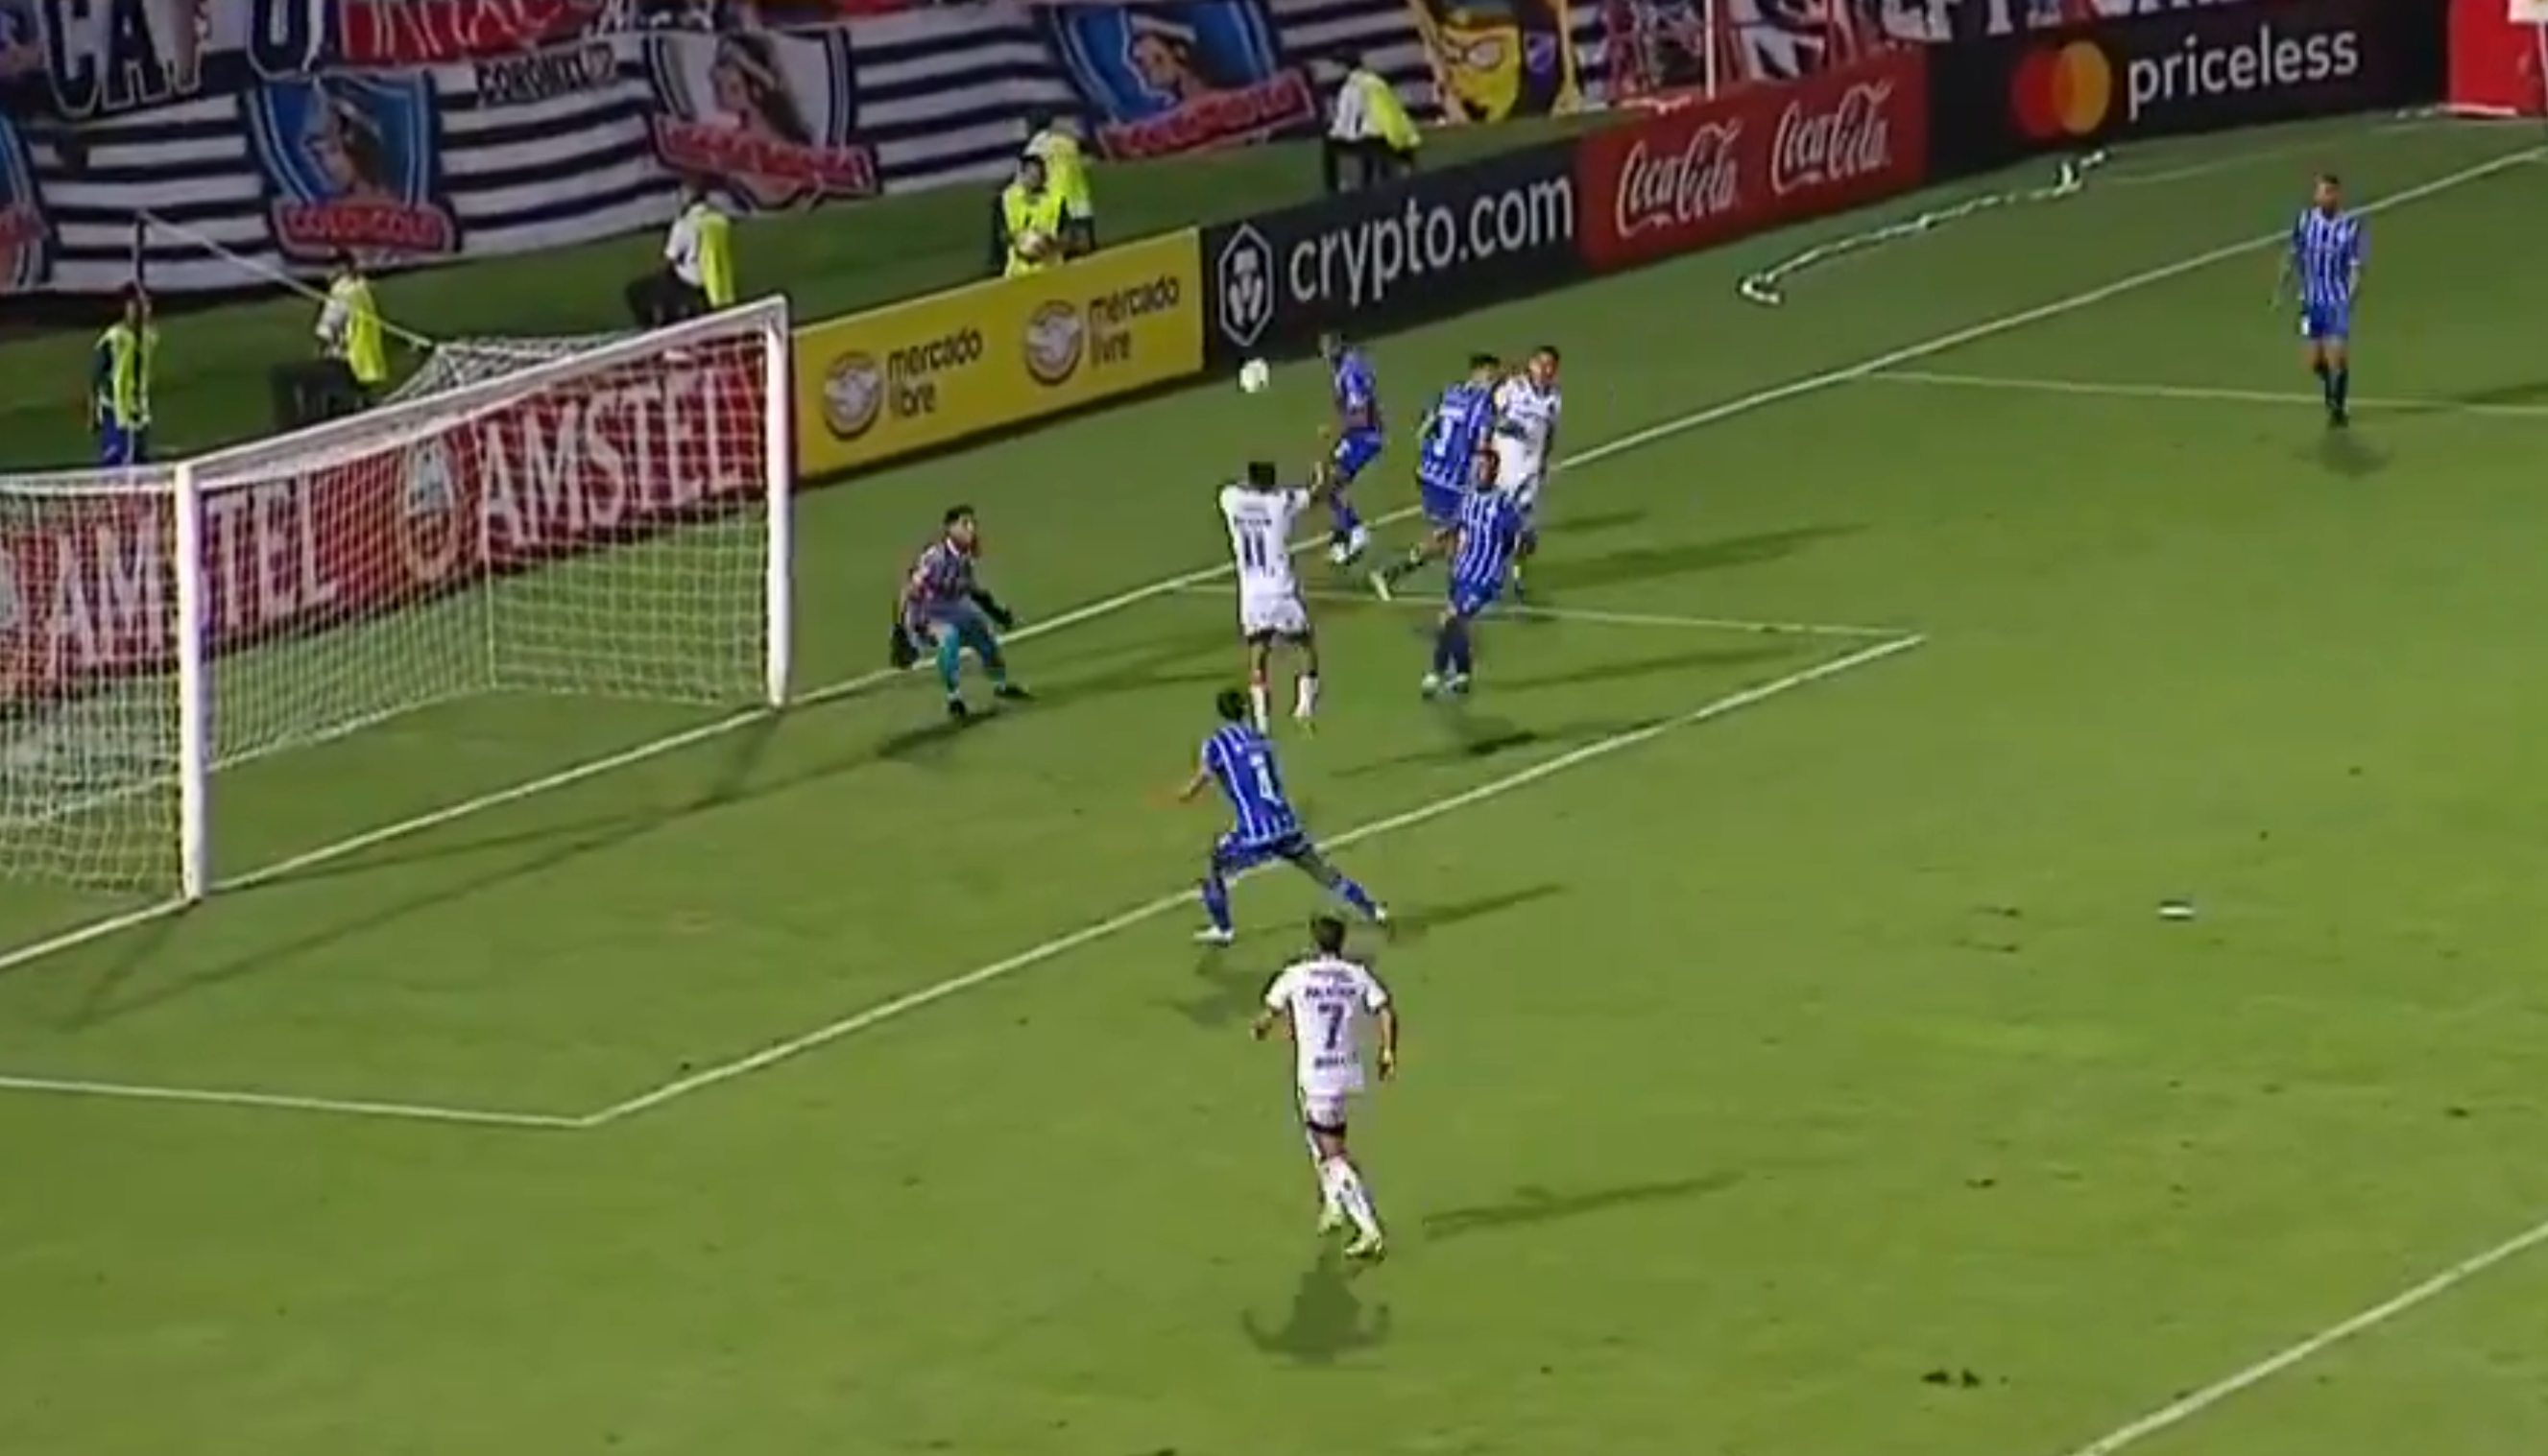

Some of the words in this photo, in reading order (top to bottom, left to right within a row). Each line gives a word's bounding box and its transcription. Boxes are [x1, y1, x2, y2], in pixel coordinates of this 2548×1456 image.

[2127, 24, 2359, 119] priceless
[1616, 117, 1741, 237] Coca-Cola
[1771, 79, 1892, 194] Coca-Cola
[1289, 174, 1574, 307] crypto.com
[887, 324, 983, 381] mercado
[1089, 274, 1180, 332] mercado
[483, 368, 744, 548] AMSTEL
[46, 468, 339, 674] AMTEL
[1243, 530, 1266, 569] 11
[1318, 1002, 1344, 1050] 7
